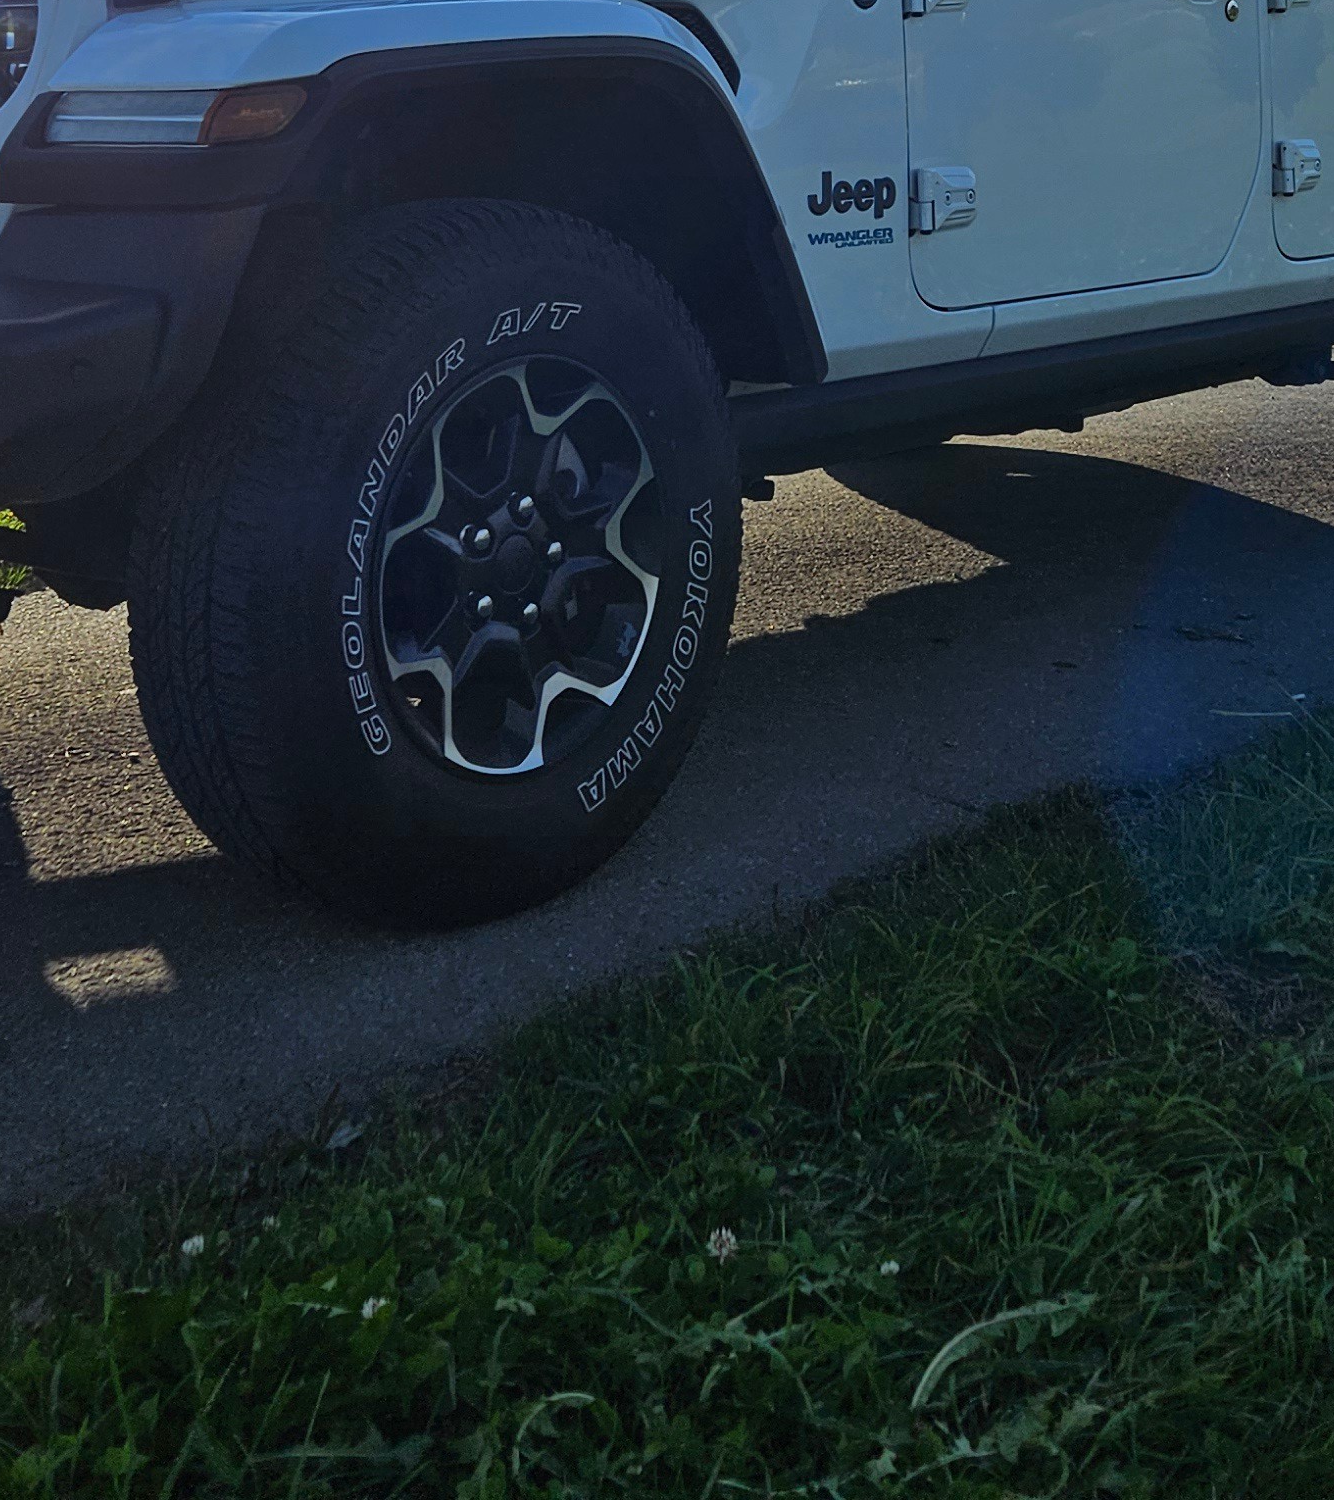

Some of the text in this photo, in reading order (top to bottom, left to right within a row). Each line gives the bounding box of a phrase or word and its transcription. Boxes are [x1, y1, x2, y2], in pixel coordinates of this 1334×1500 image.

[807, 171, 896, 219] Jeep
[807, 227, 893, 245] WRANGLER
[835, 237, 894, 248] UNLIMITED
[342, 302, 581, 755] GEOLANDAR A/T
[577, 499, 713, 813] YOKOHAMA
